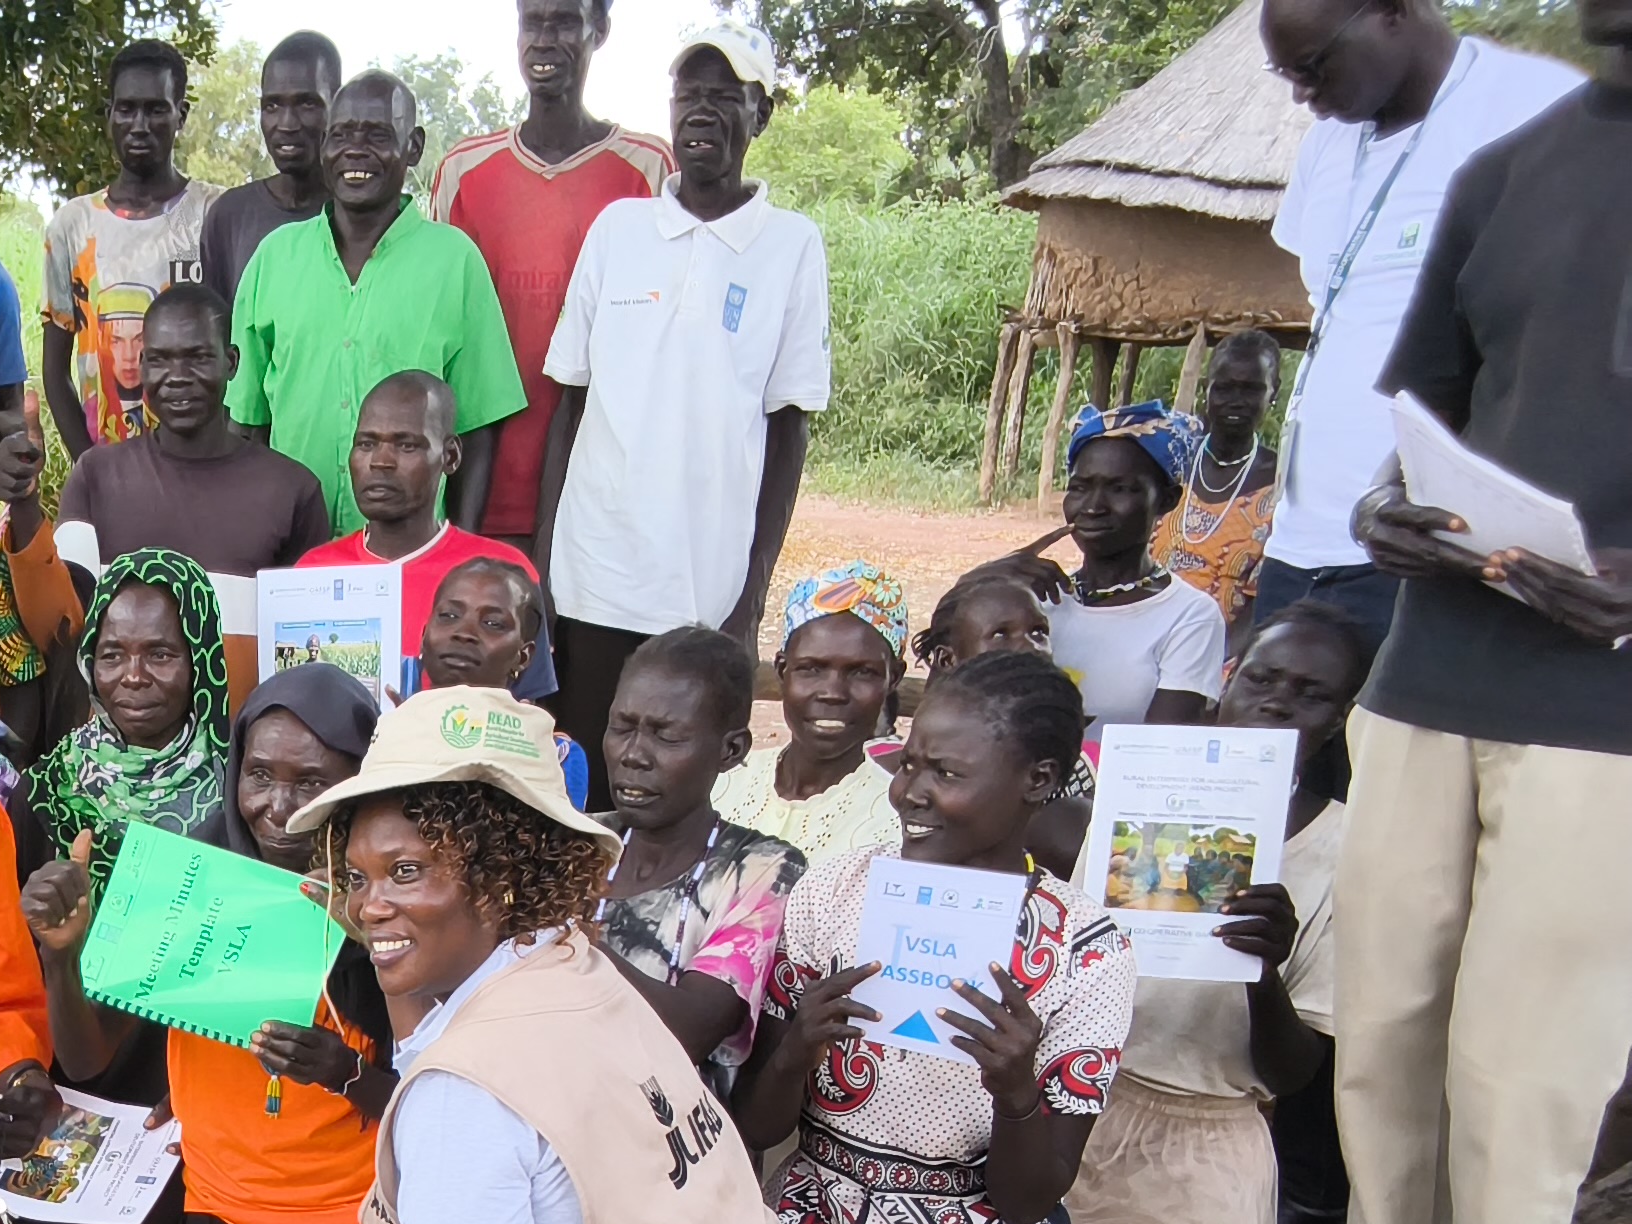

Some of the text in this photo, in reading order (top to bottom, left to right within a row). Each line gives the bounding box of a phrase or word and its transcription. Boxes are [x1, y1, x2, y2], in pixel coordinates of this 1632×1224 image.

[488, 711, 522, 729] READ
[135, 852, 202, 1002] Meeting Minutes
[180, 897, 224, 980] Template
[217, 924, 252, 976] VSLA
[906, 936, 958, 960] VSLA
